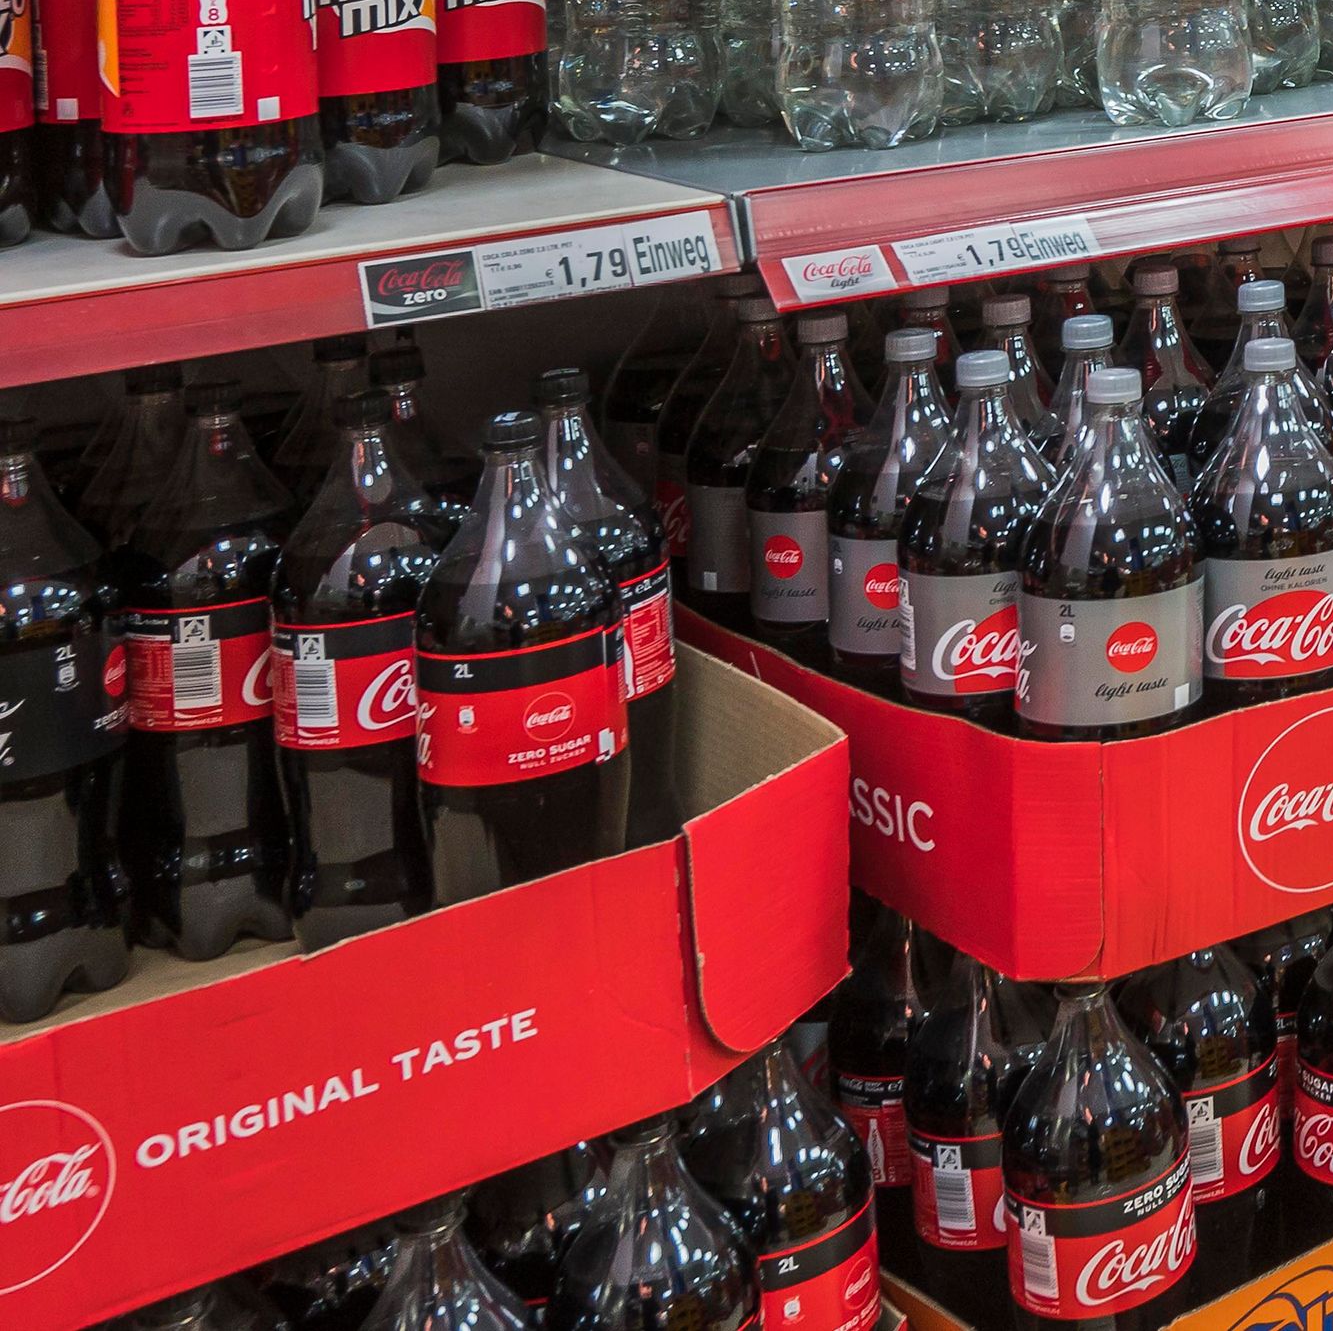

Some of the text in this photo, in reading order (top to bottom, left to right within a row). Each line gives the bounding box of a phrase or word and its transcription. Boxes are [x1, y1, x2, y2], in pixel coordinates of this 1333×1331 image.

[632, 233, 710, 275] Einweg
[966, 240, 1025, 267] 1,79
[1022, 231, 1088, 261] Einweg
[558, 248, 627, 288] 1,79
[403, 287, 447, 305] zero
[830, 277, 860, 289] light
[1107, 635, 1156, 657] Coca-Cola
[455, 664, 474, 678] 2L
[508, 735, 591, 764] ZERO SUGAR
[136, 1008, 539, 1170] ORIGINAL TASTE
